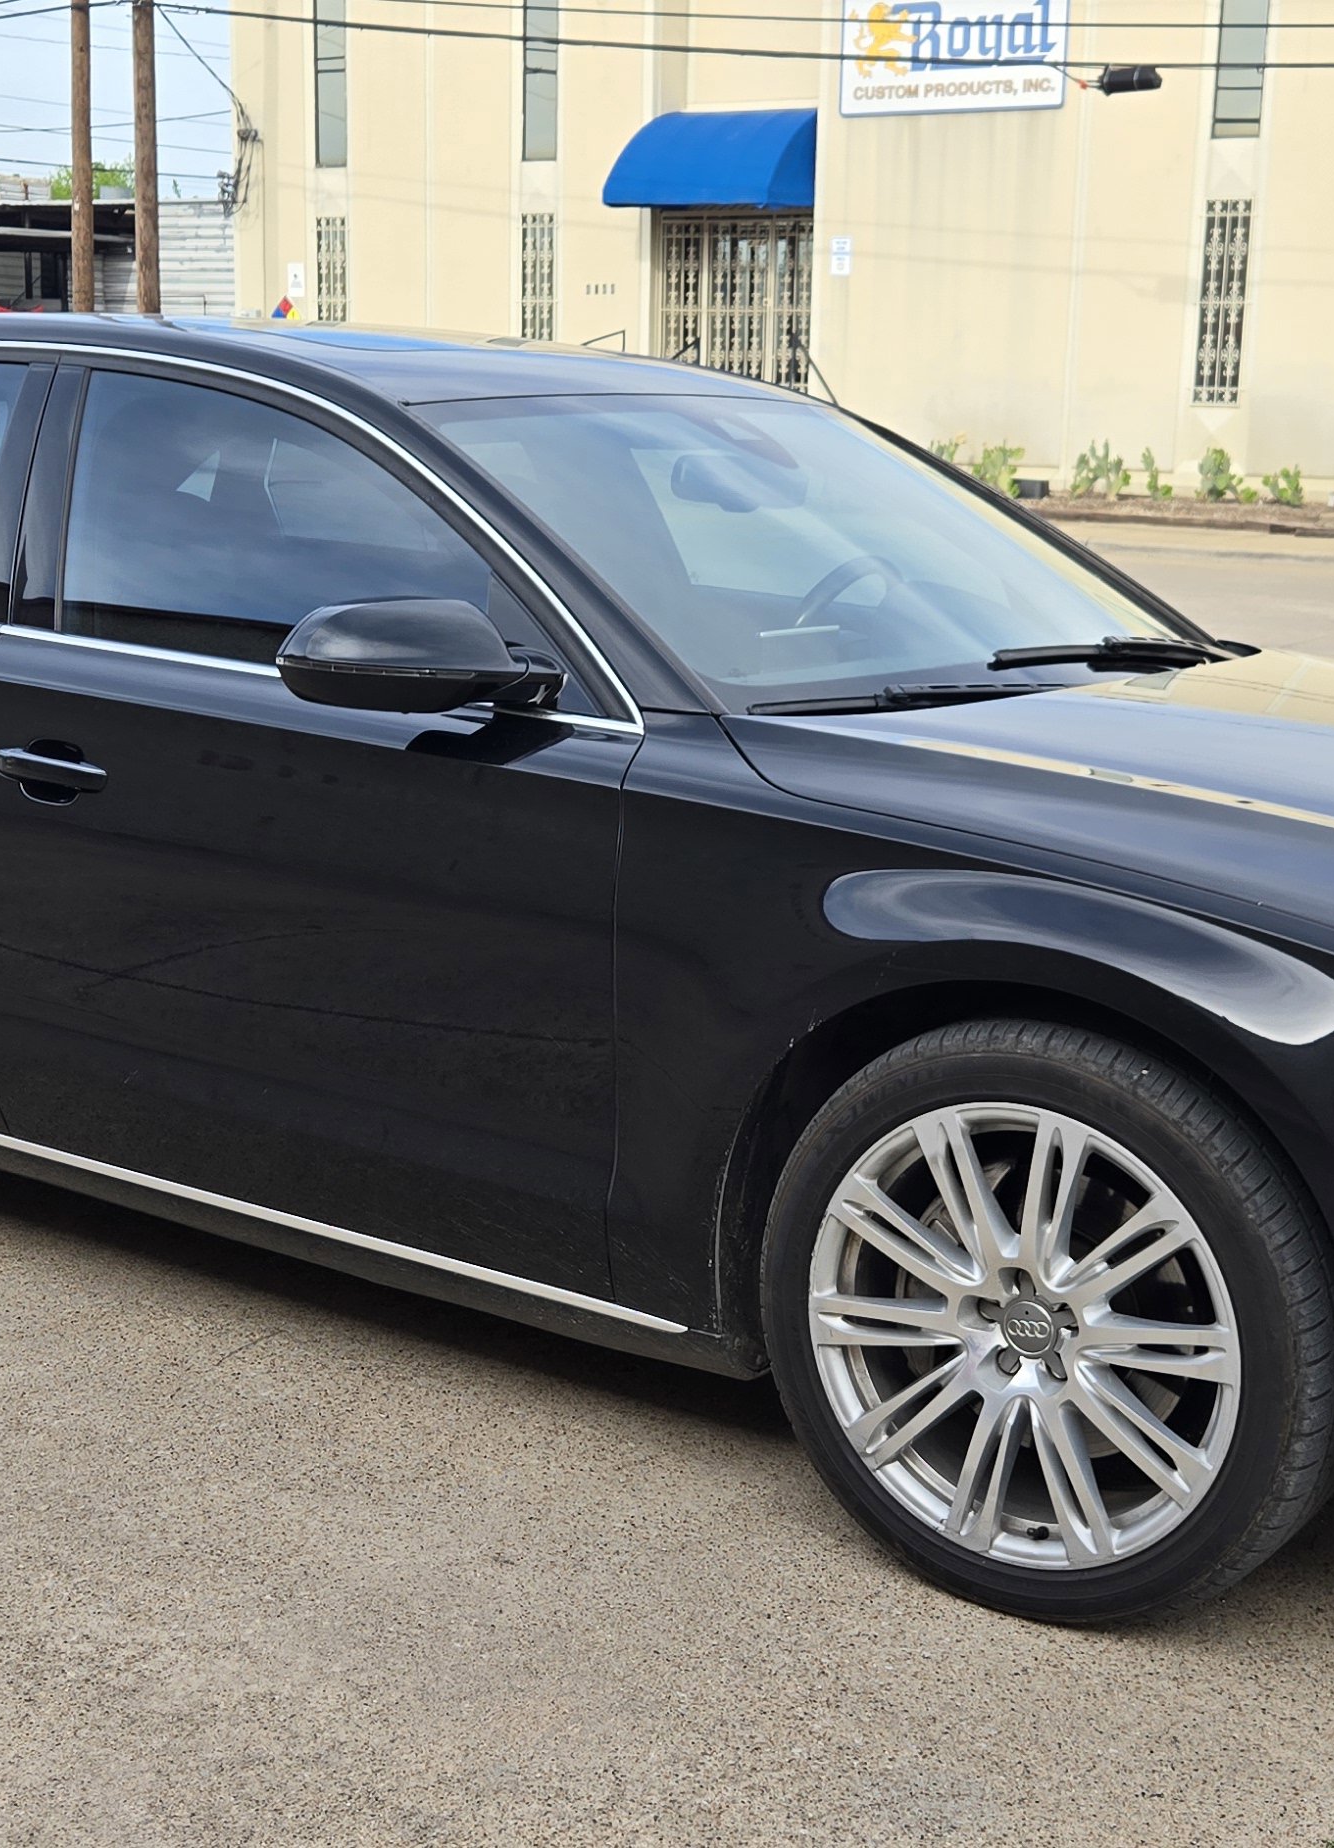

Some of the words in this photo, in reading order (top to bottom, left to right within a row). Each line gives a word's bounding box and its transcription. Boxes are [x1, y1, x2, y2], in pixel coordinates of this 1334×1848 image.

[891, 0, 1057, 72] Royal
[853, 84, 919, 101] CUSTOM
[923, 79, 1019, 98] PRODUCTS,
[1022, 77, 1056, 94] INC.
